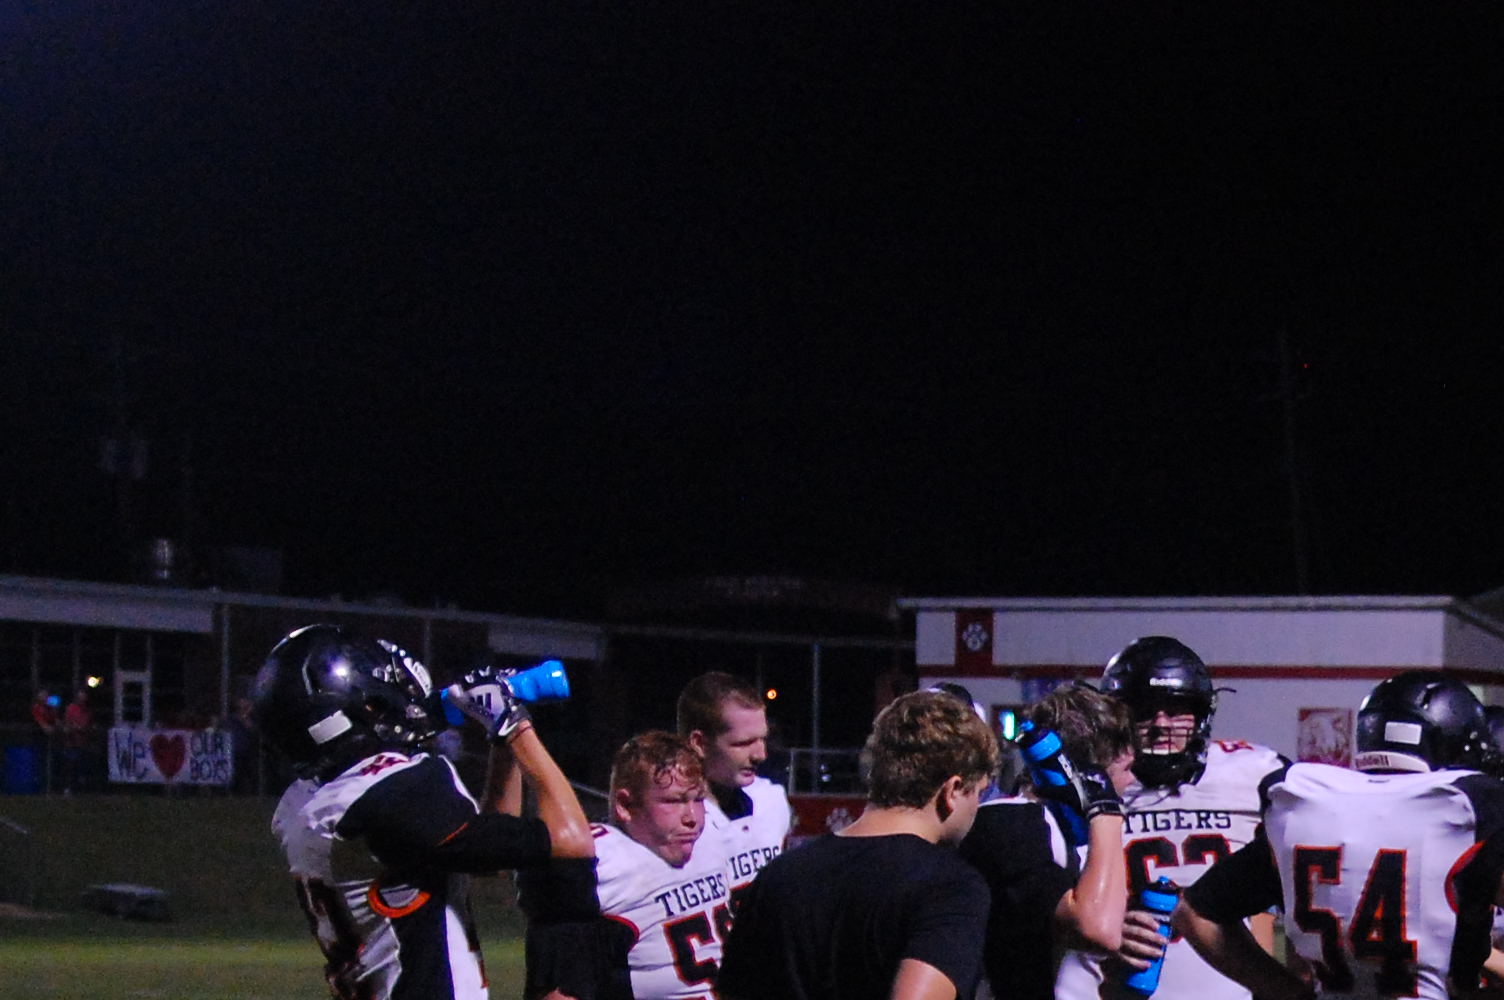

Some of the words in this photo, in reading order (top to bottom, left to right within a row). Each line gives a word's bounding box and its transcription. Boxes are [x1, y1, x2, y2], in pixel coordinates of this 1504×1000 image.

[115, 731, 148, 778] We
[1124, 809, 1231, 834] TIGERS
[654, 873, 728, 918] TIGERS
[1293, 843, 1419, 998] 54
